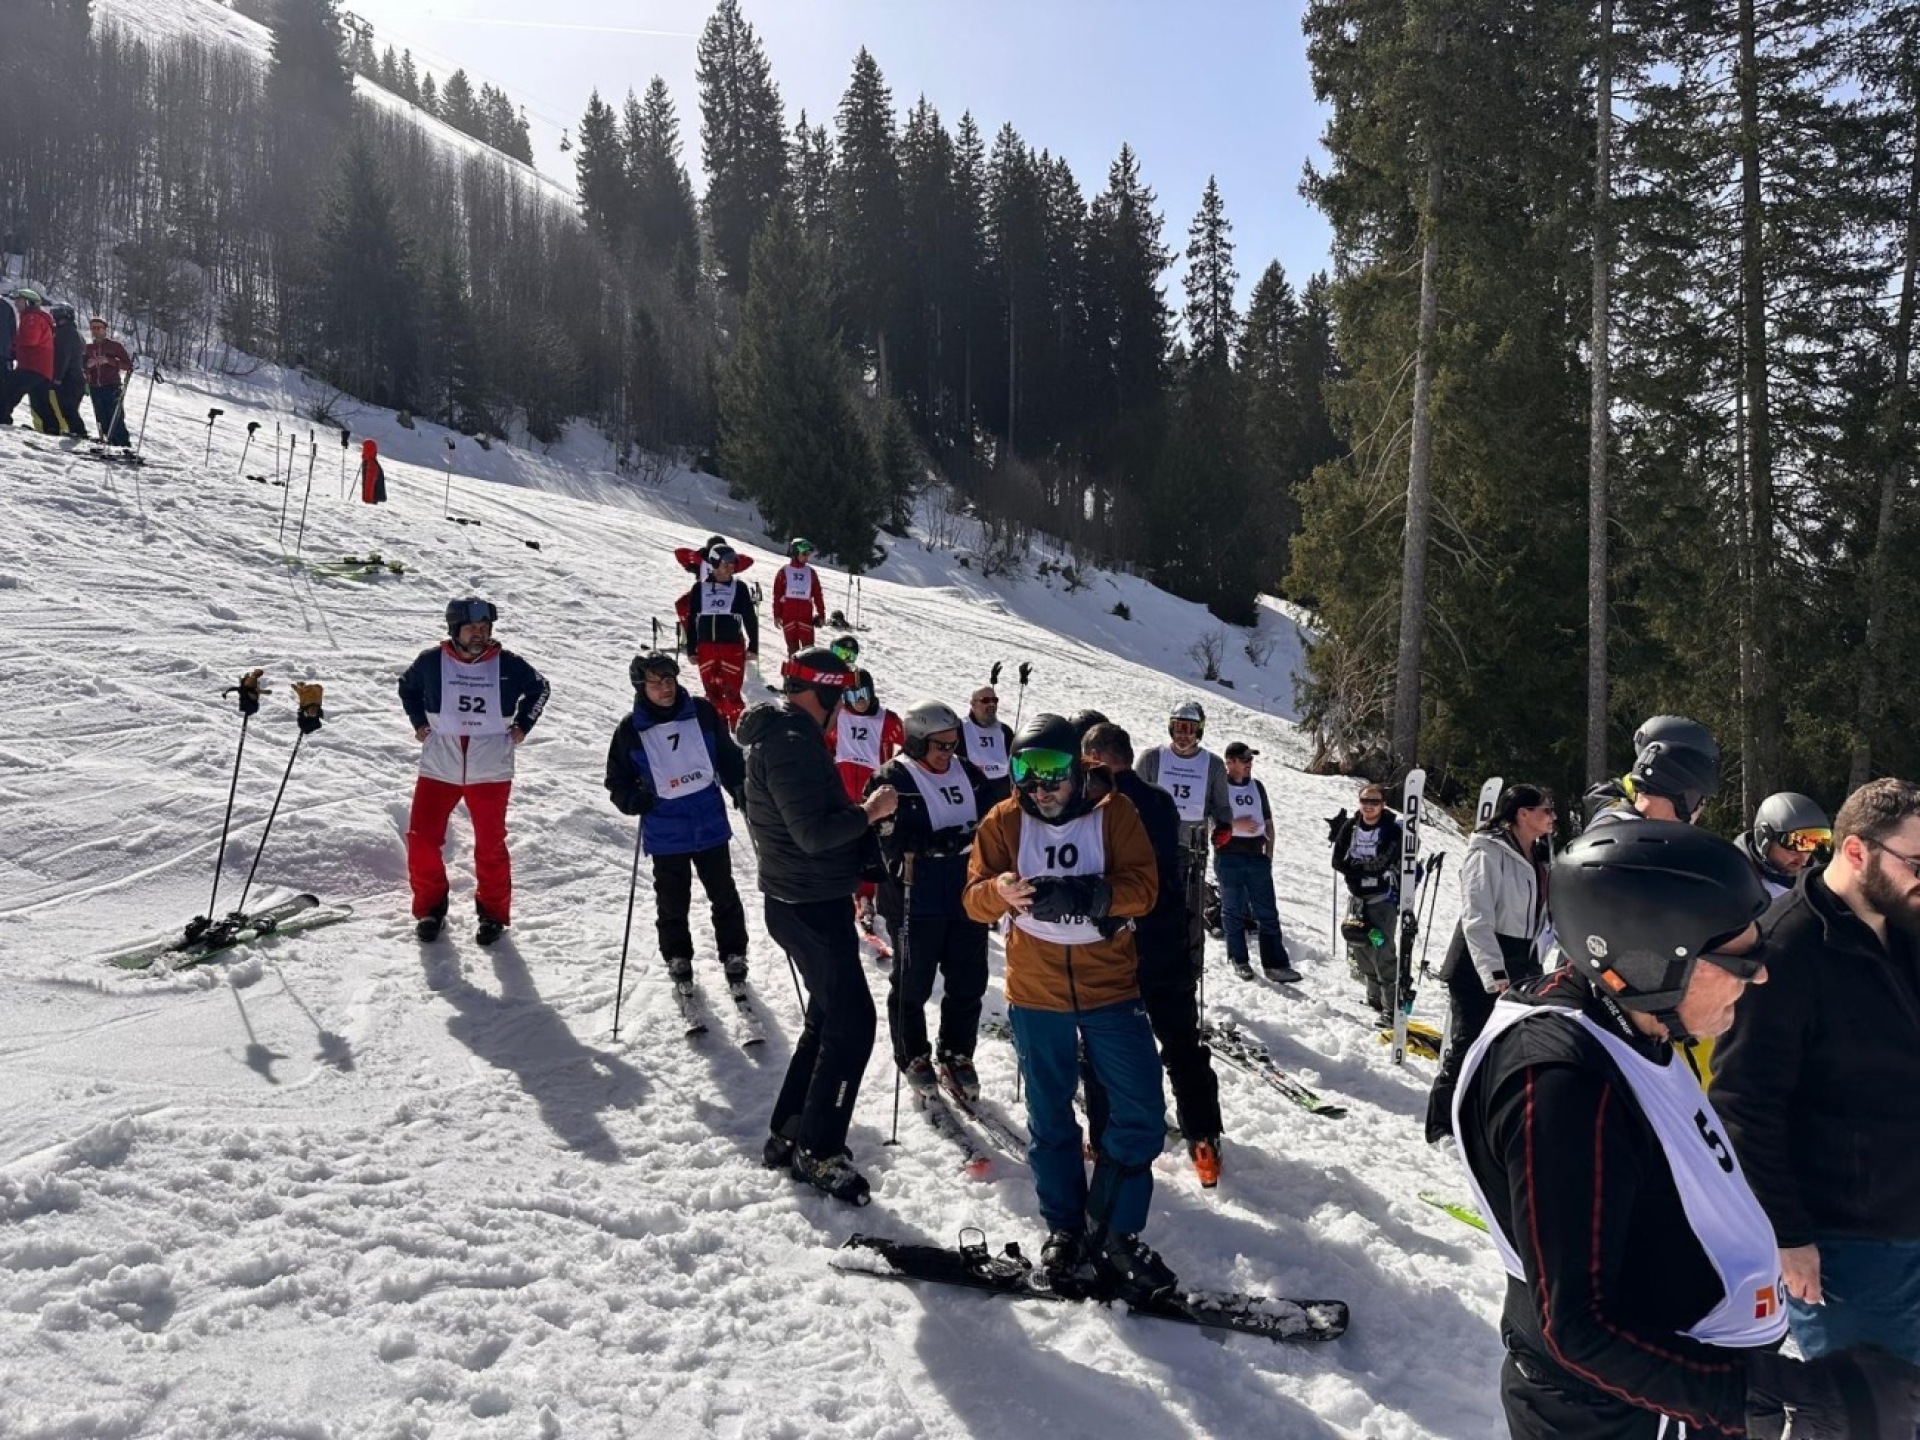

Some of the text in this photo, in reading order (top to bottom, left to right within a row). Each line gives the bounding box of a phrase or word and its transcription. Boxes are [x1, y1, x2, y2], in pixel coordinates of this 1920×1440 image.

[458, 695, 487, 714] 52
[667, 733, 680, 752] 7
[850, 727, 868, 741] 12
[979, 736, 994, 748] 31
[680, 771, 702, 784] GVB
[939, 786, 964, 806] 15
[1172, 783, 1191, 799] 13
[1235, 794, 1254, 806] 60
[1403, 795, 1418, 875] HEAD
[1044, 843, 1079, 869] 10
[1694, 1108, 1734, 1173] 5
